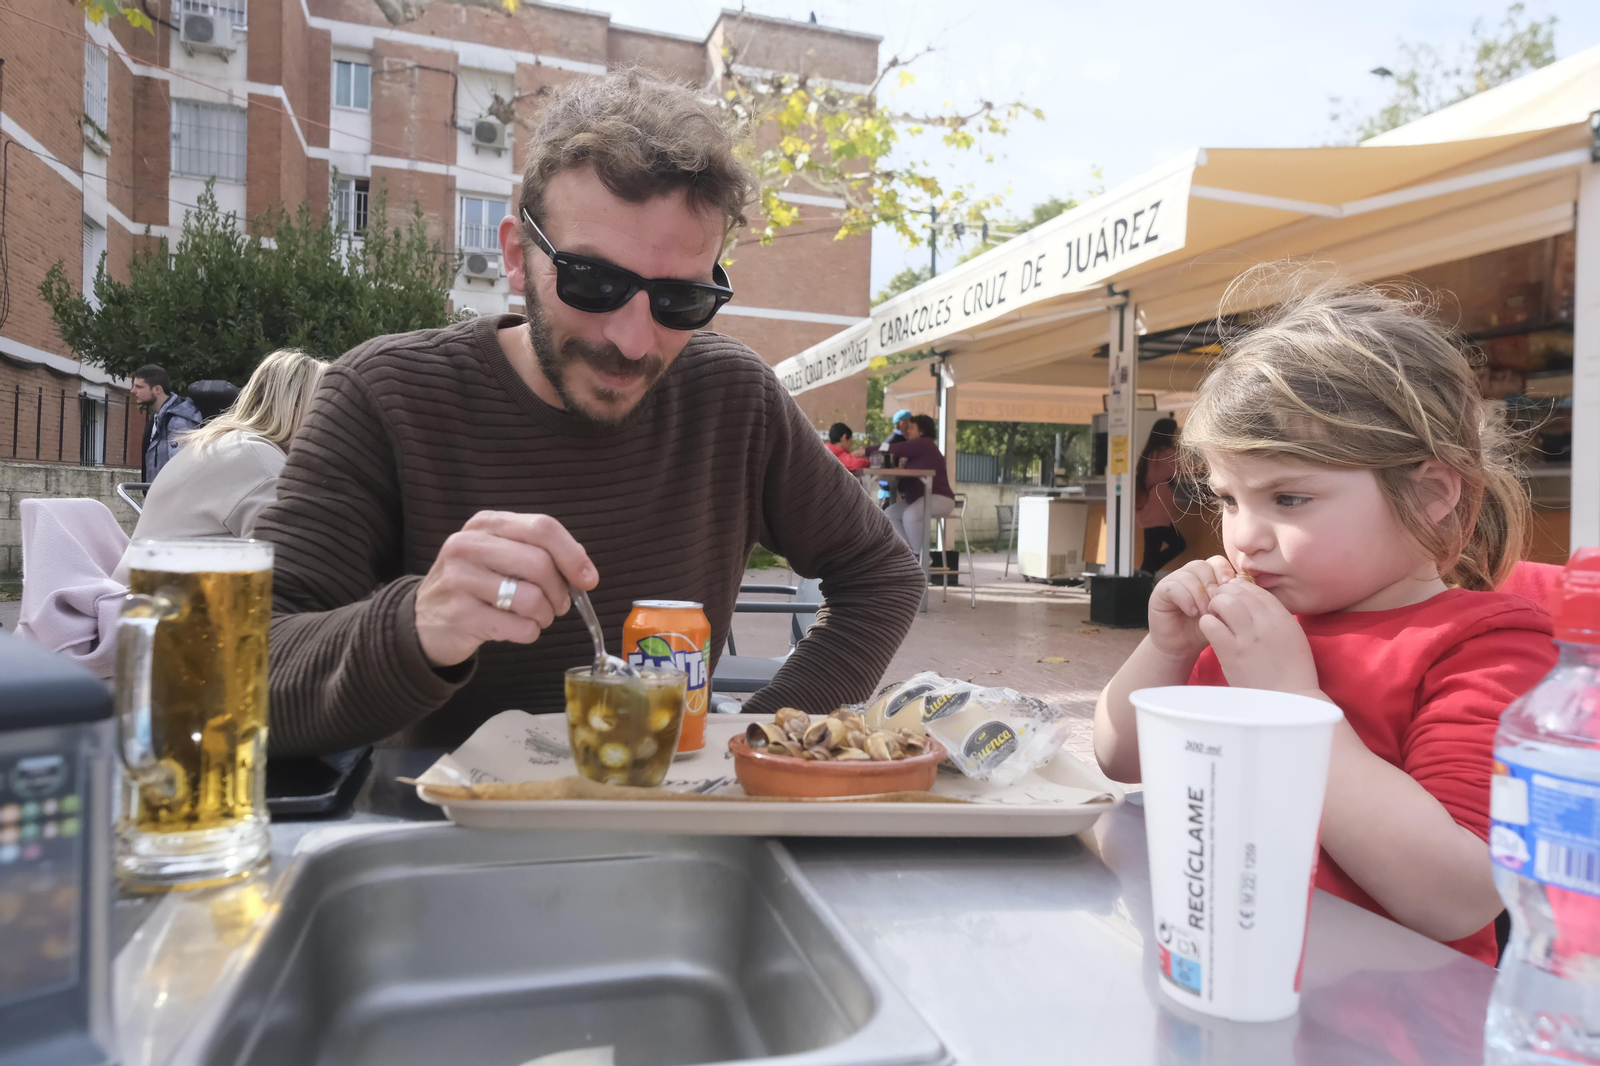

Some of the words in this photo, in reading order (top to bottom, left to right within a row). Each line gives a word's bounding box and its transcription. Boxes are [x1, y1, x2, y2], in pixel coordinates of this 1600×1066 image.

[880, 295, 953, 348] CARACOLES
[963, 271, 1007, 317] CRUZ
[1020, 254, 1046, 294] DE
[1062, 199, 1163, 279] JUÁREZ
[781, 370, 803, 391] COLES
[923, 693, 954, 718] Cuen
[970, 729, 1012, 760] Cuenca
[1183, 786, 1205, 931] RECÍCLAME
